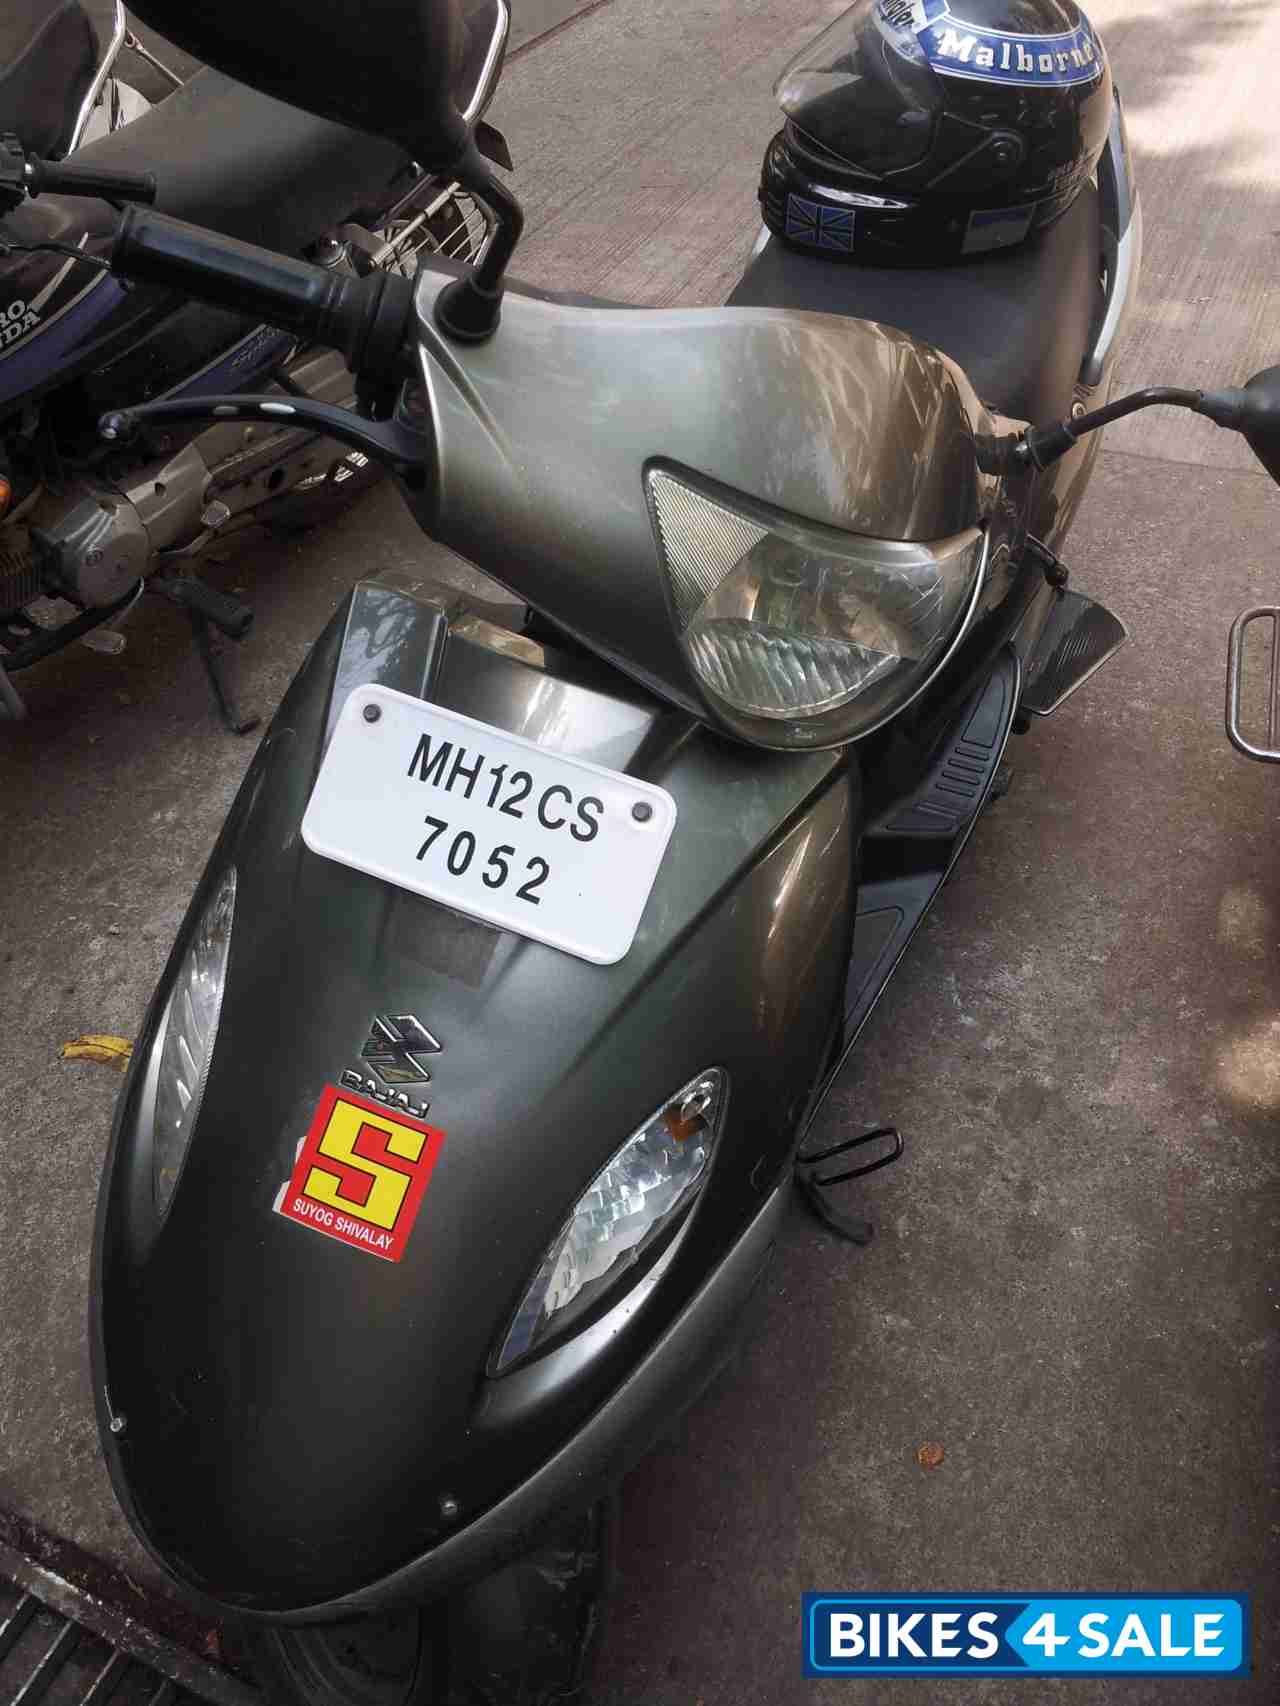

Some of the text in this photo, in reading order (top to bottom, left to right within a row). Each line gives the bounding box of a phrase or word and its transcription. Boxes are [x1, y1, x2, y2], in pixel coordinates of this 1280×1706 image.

[407, 733, 605, 842] MH12CS
[416, 815, 551, 905] 7052
[340, 1068, 431, 1119] BAJAJ
[302, 1097, 428, 1232] S
[293, 1198, 394, 1250] SUYOG SHIVALAY
